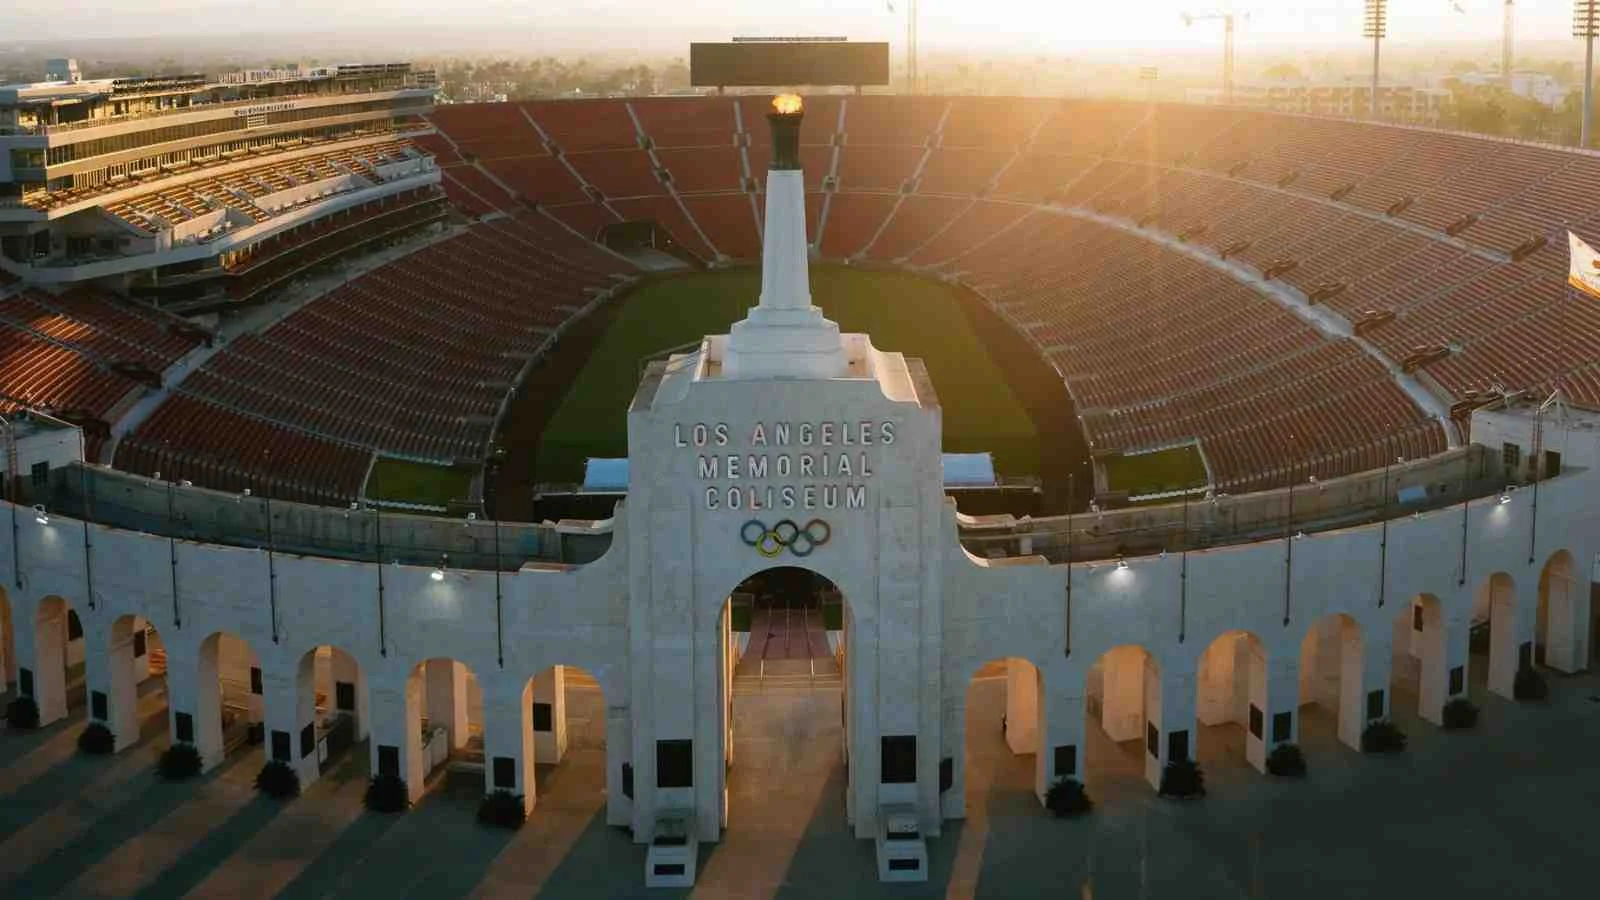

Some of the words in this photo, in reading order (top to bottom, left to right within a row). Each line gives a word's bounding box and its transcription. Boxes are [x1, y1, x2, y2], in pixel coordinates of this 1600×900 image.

[674, 422, 729, 448] LOS
[751, 421, 897, 446] ANGELES
[699, 454, 873, 479] MEMORIAL
[705, 485, 866, 510] COLISEUM
